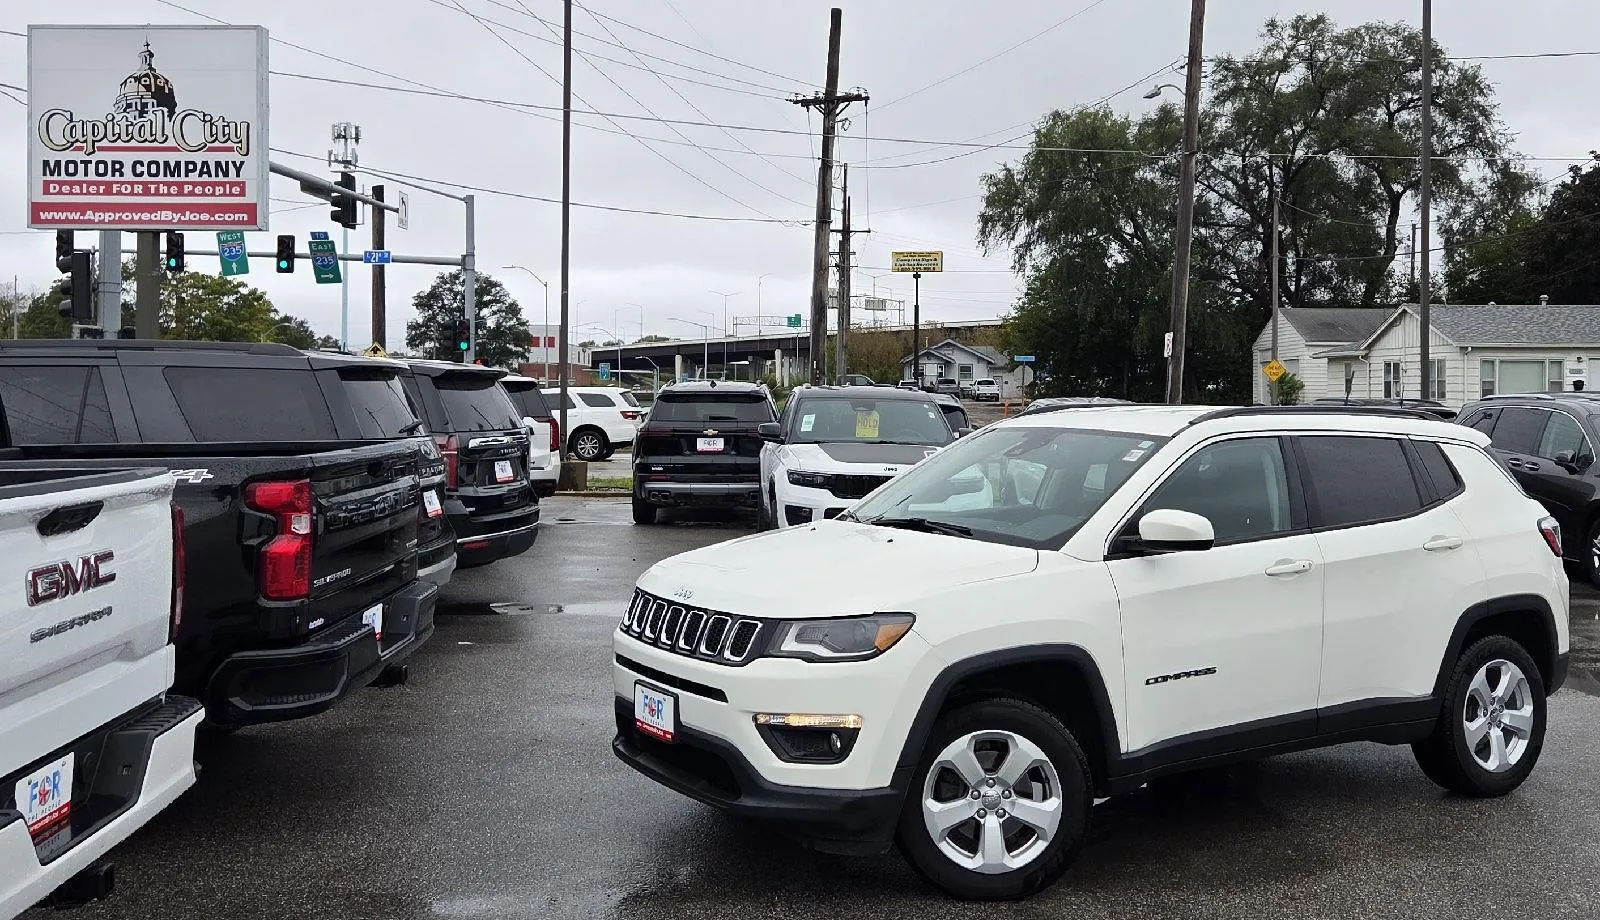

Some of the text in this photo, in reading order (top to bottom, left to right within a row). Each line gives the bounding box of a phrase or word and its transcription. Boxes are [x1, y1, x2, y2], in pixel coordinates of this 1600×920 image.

[38, 108, 250, 156] Capital City
[42, 160, 246, 178] MOTOR COMPANY
[49, 183, 242, 196] Dealer FOR The People
[39, 210, 248, 223] www.ApprovedByJoe.com
[220, 233, 241, 241] WEST
[224, 246, 242, 256] 235
[316, 256, 334, 265] 235
[857, 415, 878, 428] HOLD
[25, 549, 117, 607] GMC
[30, 605, 113, 643] SIERRA
[1145, 666, 1217, 686] COMPASS
